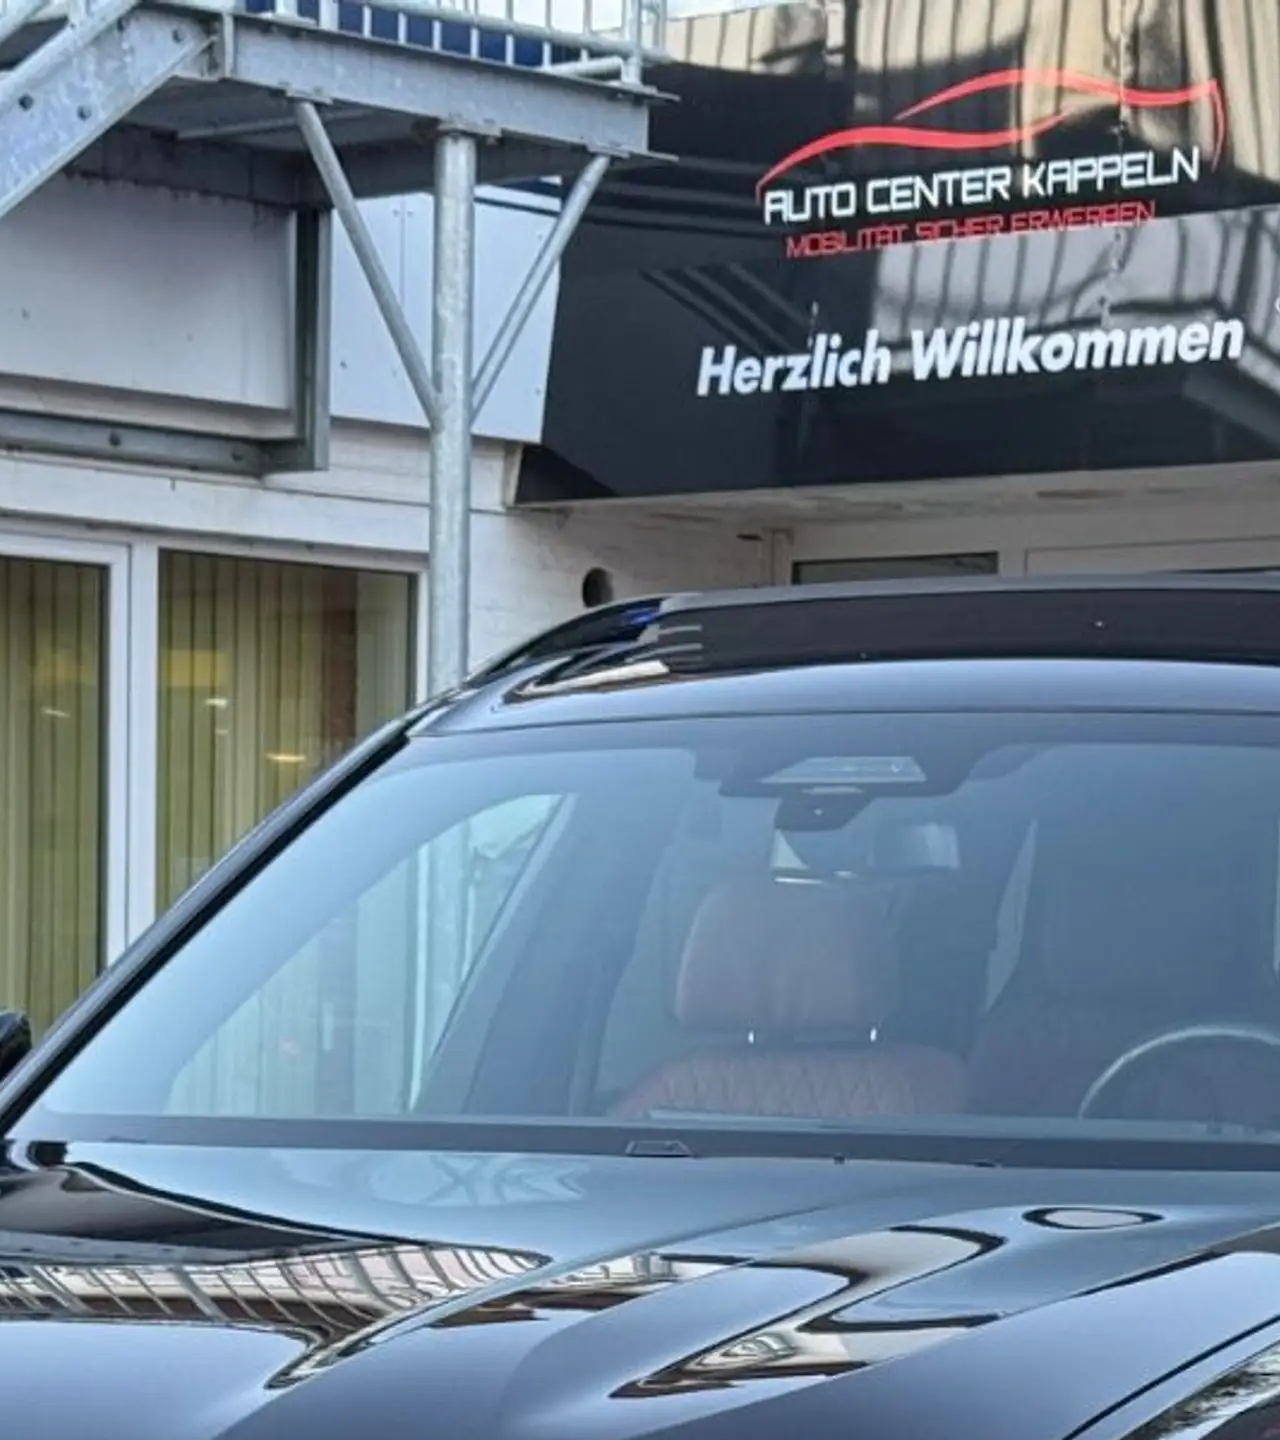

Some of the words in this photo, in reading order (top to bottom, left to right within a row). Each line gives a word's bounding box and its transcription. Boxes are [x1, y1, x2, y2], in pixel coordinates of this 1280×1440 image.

[764, 182, 857, 226] AUTO
[866, 165, 1011, 214] CENTER
[1022, 145, 1200, 198] KAPPELN
[915, 211, 1004, 243] SICHER
[1009, 200, 1156, 233] ERWERBEN
[696, 328, 892, 397] Herzlich
[911, 316, 1244, 381] Willkommen
